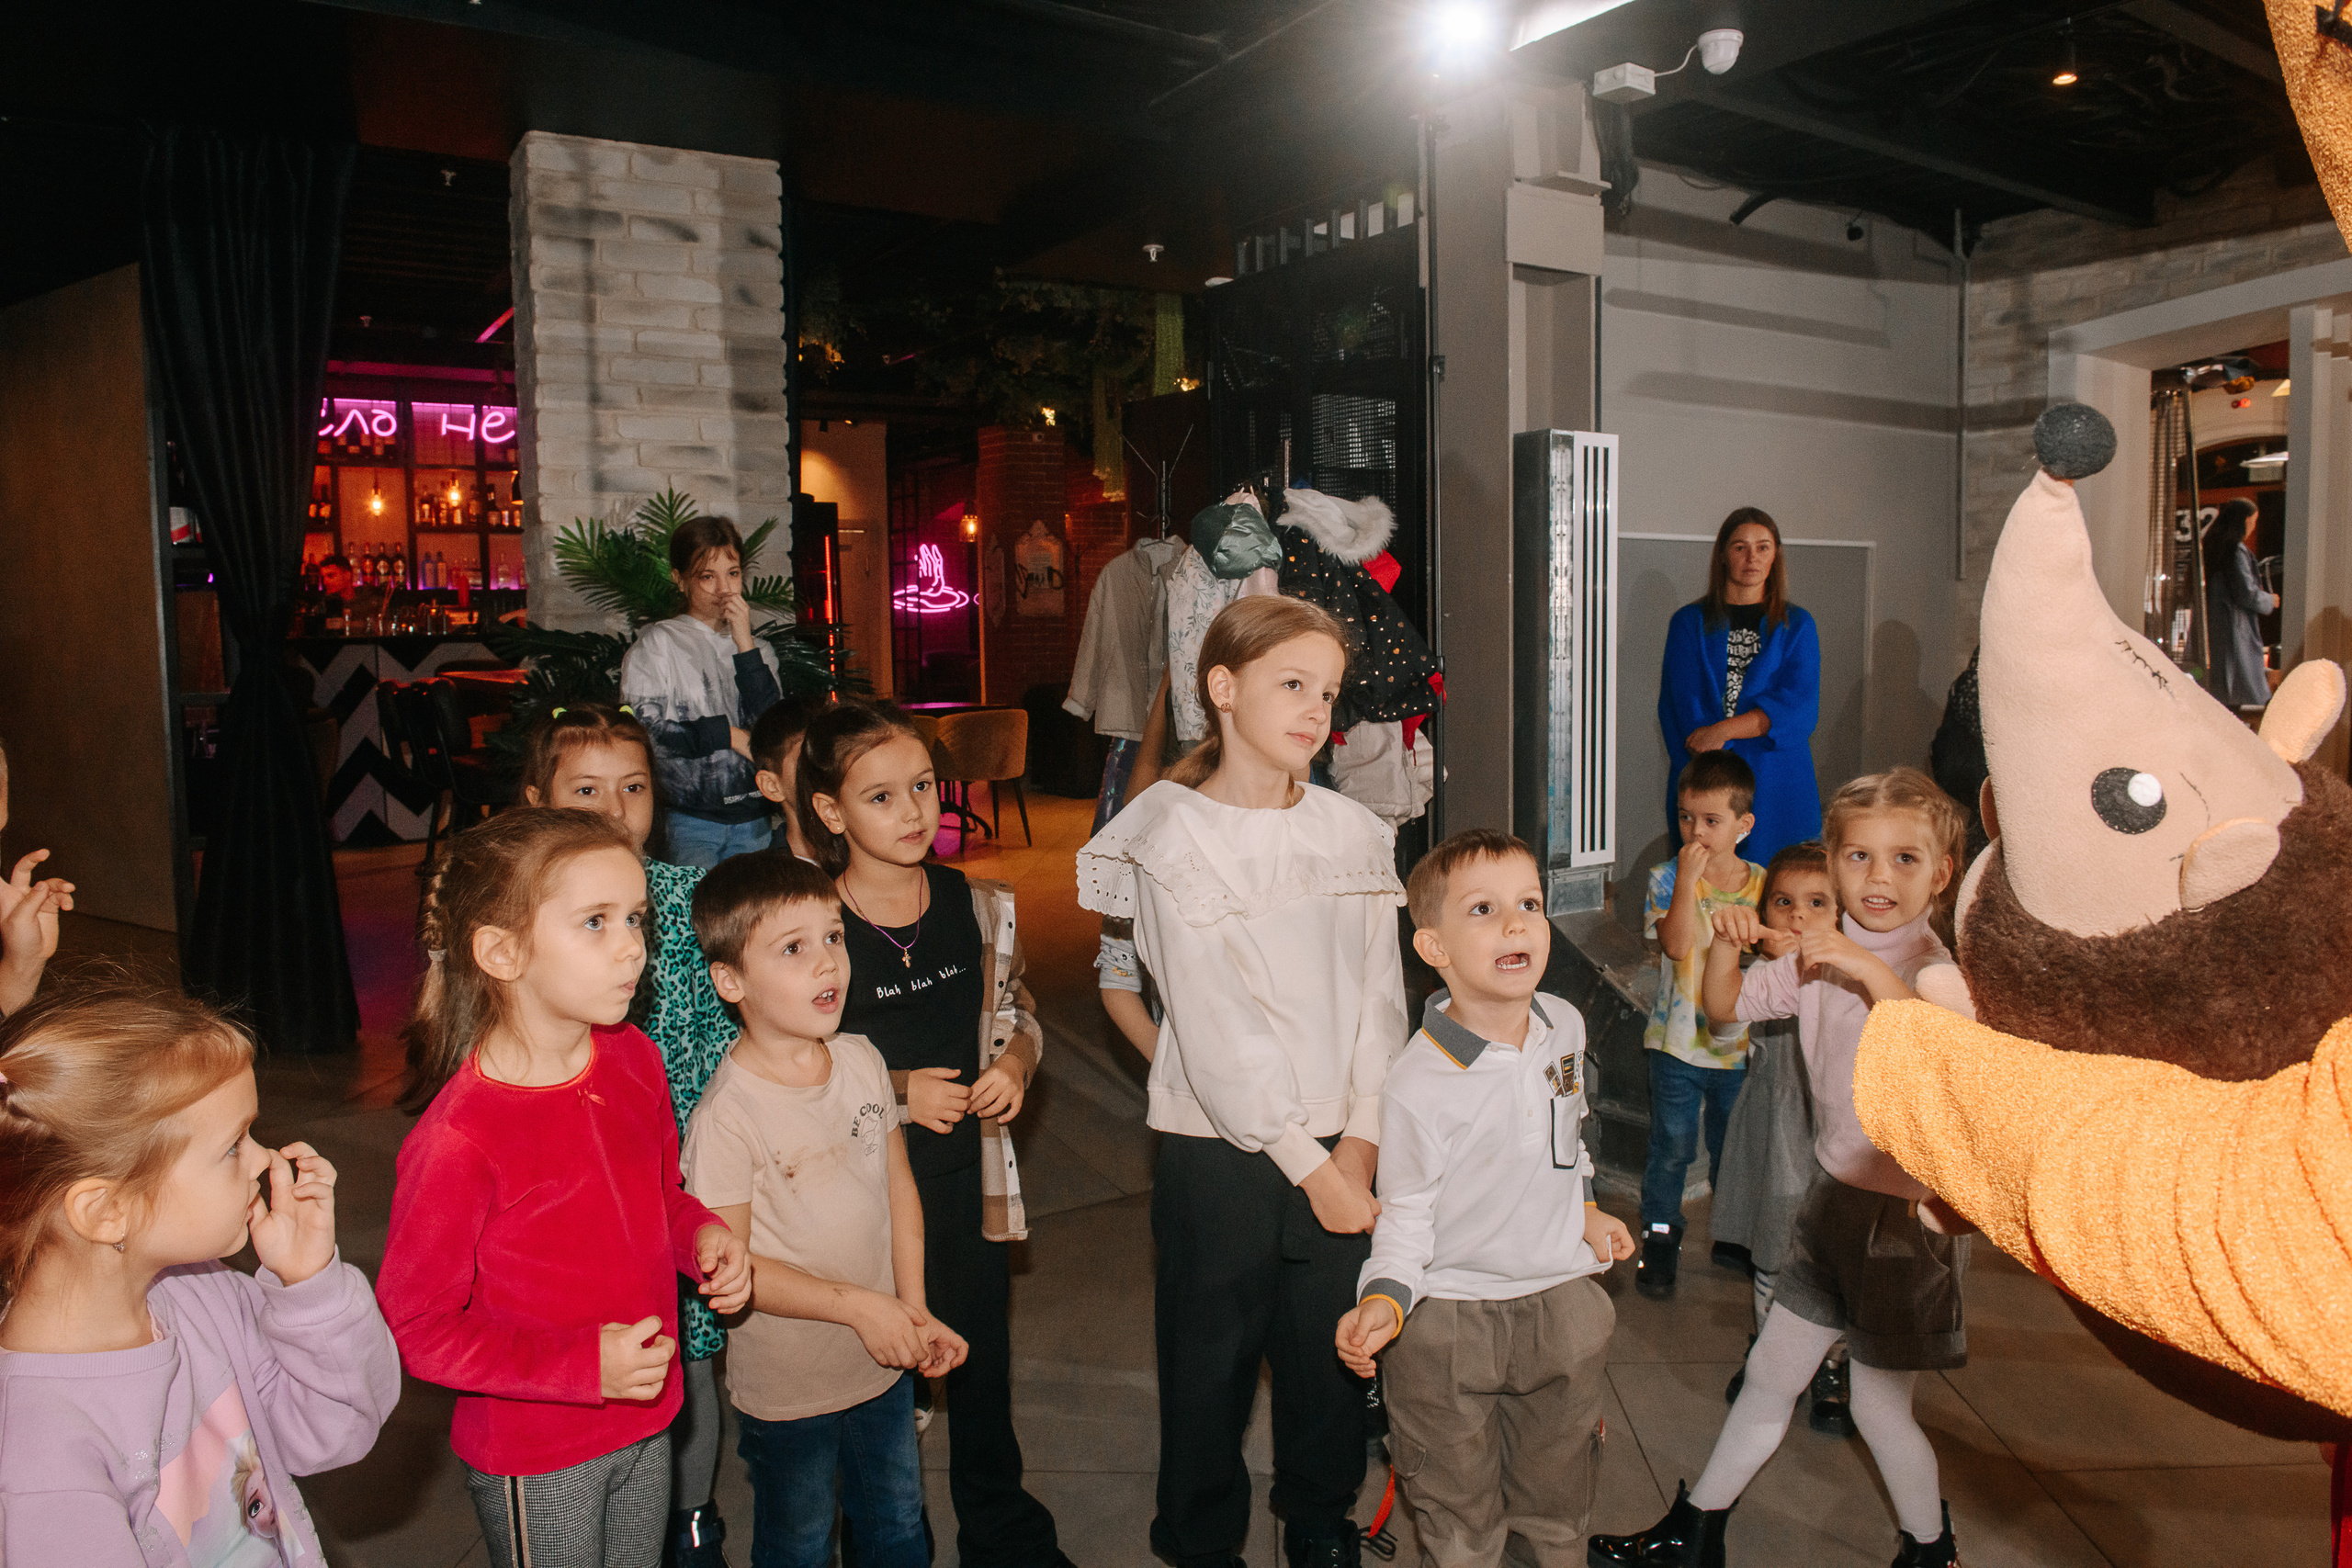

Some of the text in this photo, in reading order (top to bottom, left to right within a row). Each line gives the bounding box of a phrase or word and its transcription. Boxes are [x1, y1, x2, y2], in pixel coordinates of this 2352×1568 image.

[876, 984, 901, 998] Blah
[910, 976, 933, 991] blah
[851, 1102, 884, 1137] BE COOL
